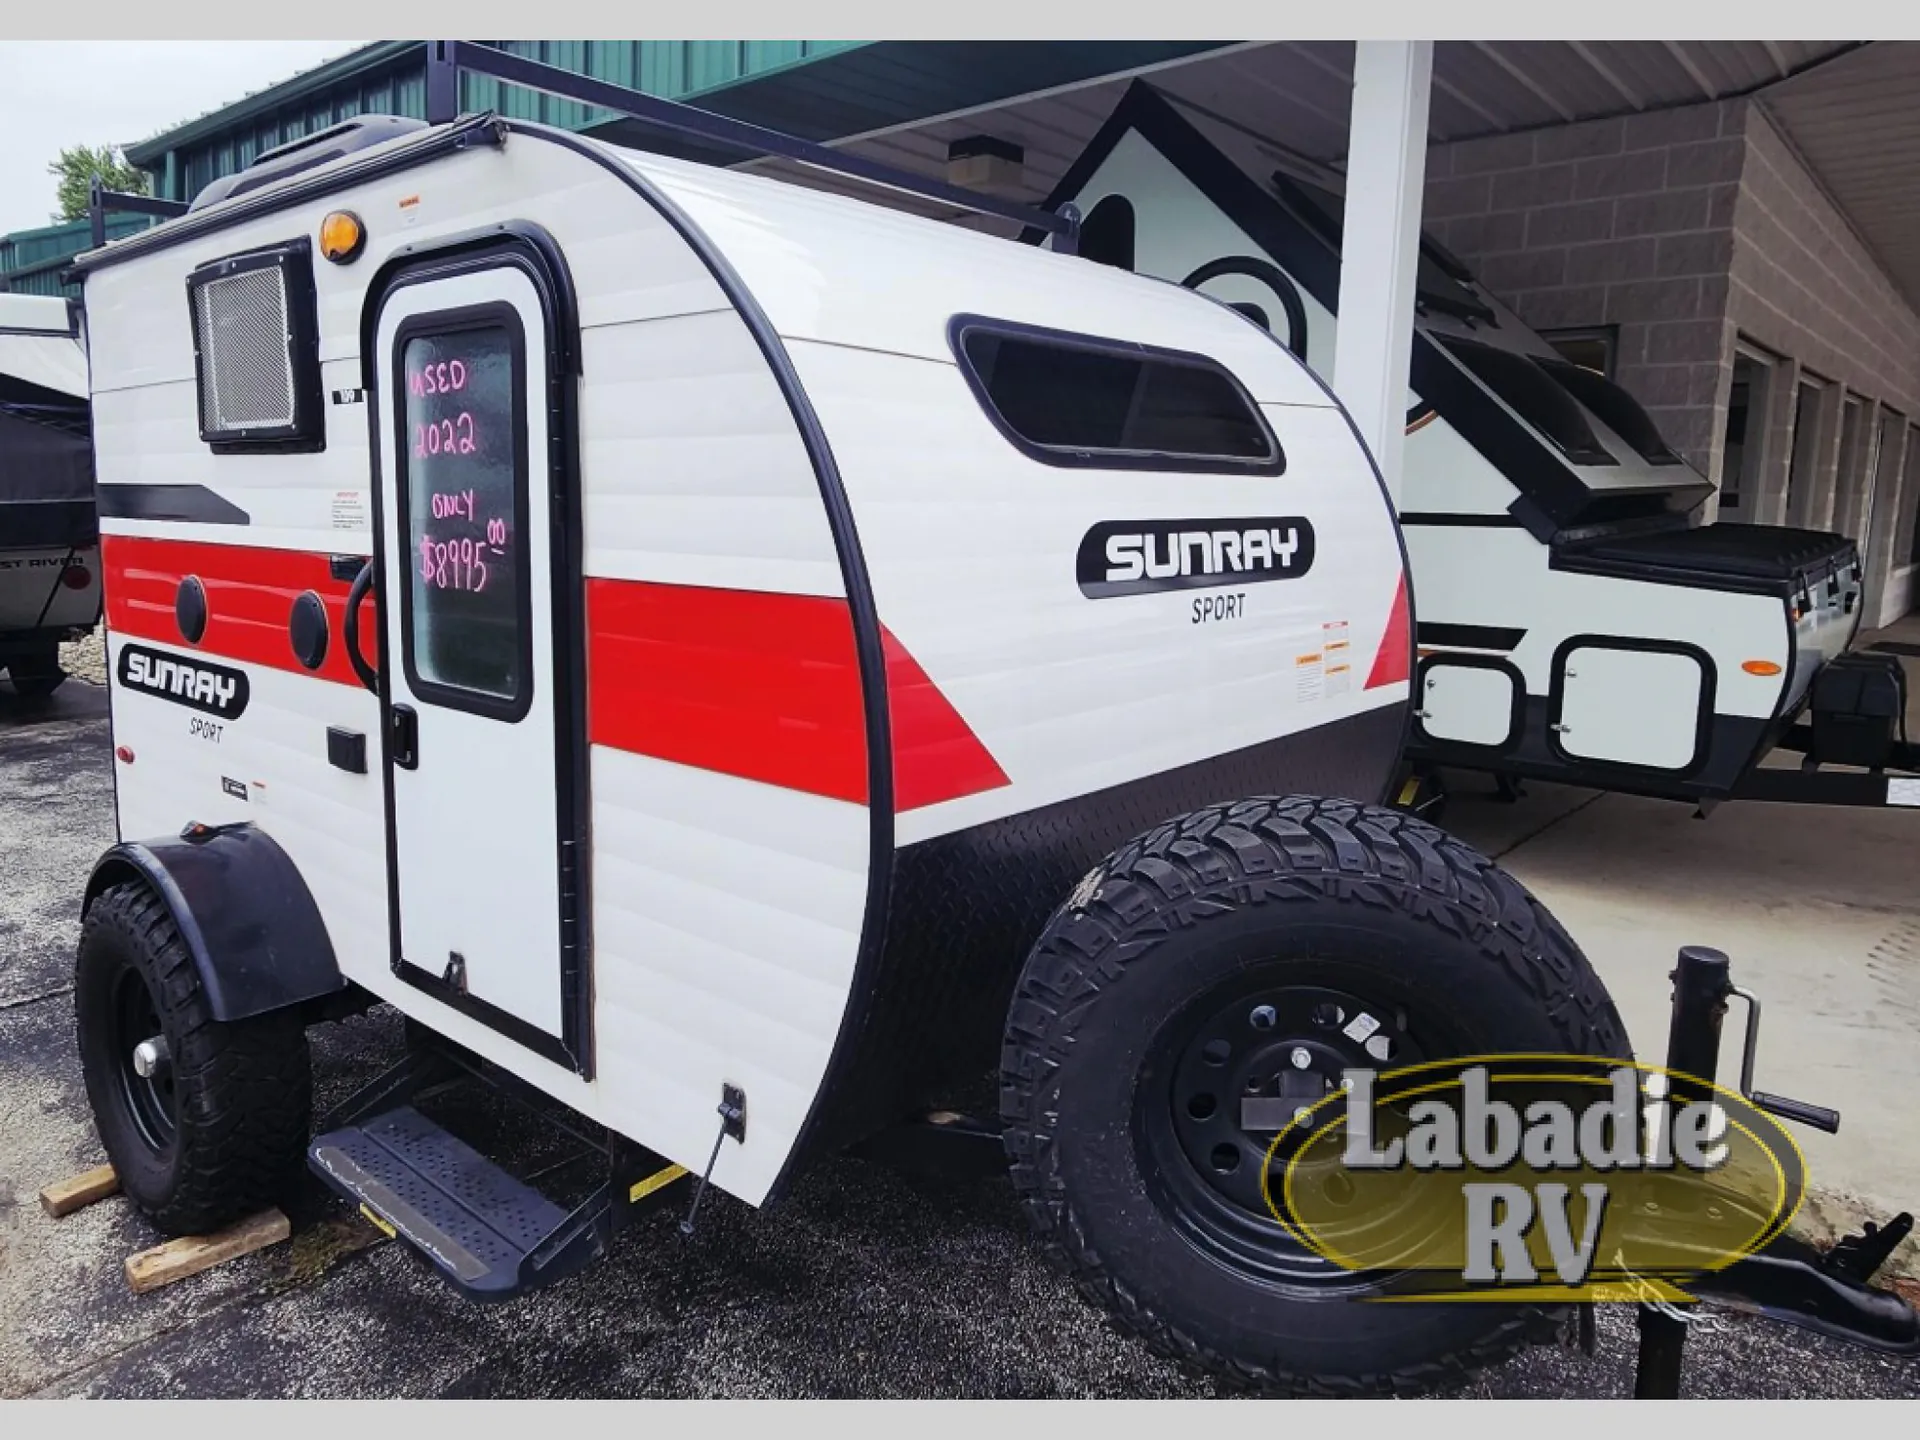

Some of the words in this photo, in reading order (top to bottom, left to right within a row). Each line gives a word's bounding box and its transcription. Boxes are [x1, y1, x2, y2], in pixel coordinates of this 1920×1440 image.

[414, 412, 476, 459] 2022
[432, 489, 474, 521] ONLY
[1105, 528, 1299, 581] SUNRAY
[1191, 593, 1246, 623] SPORT
[126, 652, 236, 708] SUNRAY
[189, 717, 224, 743] SPORT
